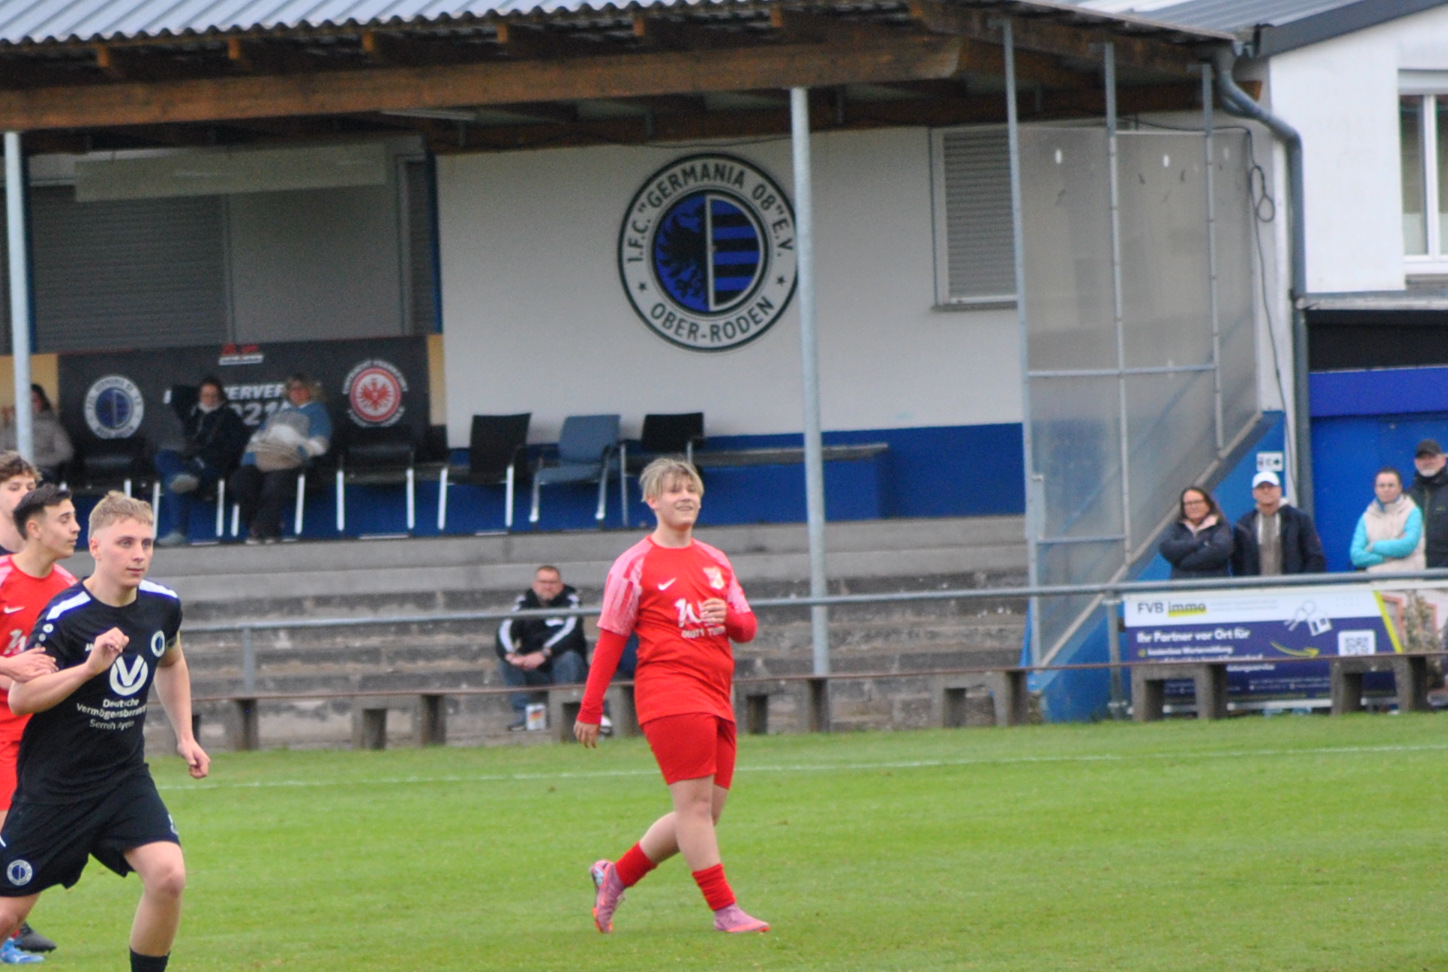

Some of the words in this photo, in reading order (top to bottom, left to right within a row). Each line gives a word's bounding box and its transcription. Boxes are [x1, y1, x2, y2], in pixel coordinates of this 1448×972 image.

[650, 295, 776, 343] OBER-RODEN
[1137, 602, 1164, 614] FVB
[1168, 600, 1206, 613] immo
[1137, 631, 1152, 643] Ihr
[1154, 629, 1193, 643] Partner
[1195, 631, 1213, 641] vor
[1214, 628, 1233, 640] Ort
[1234, 627, 1251, 639] für
